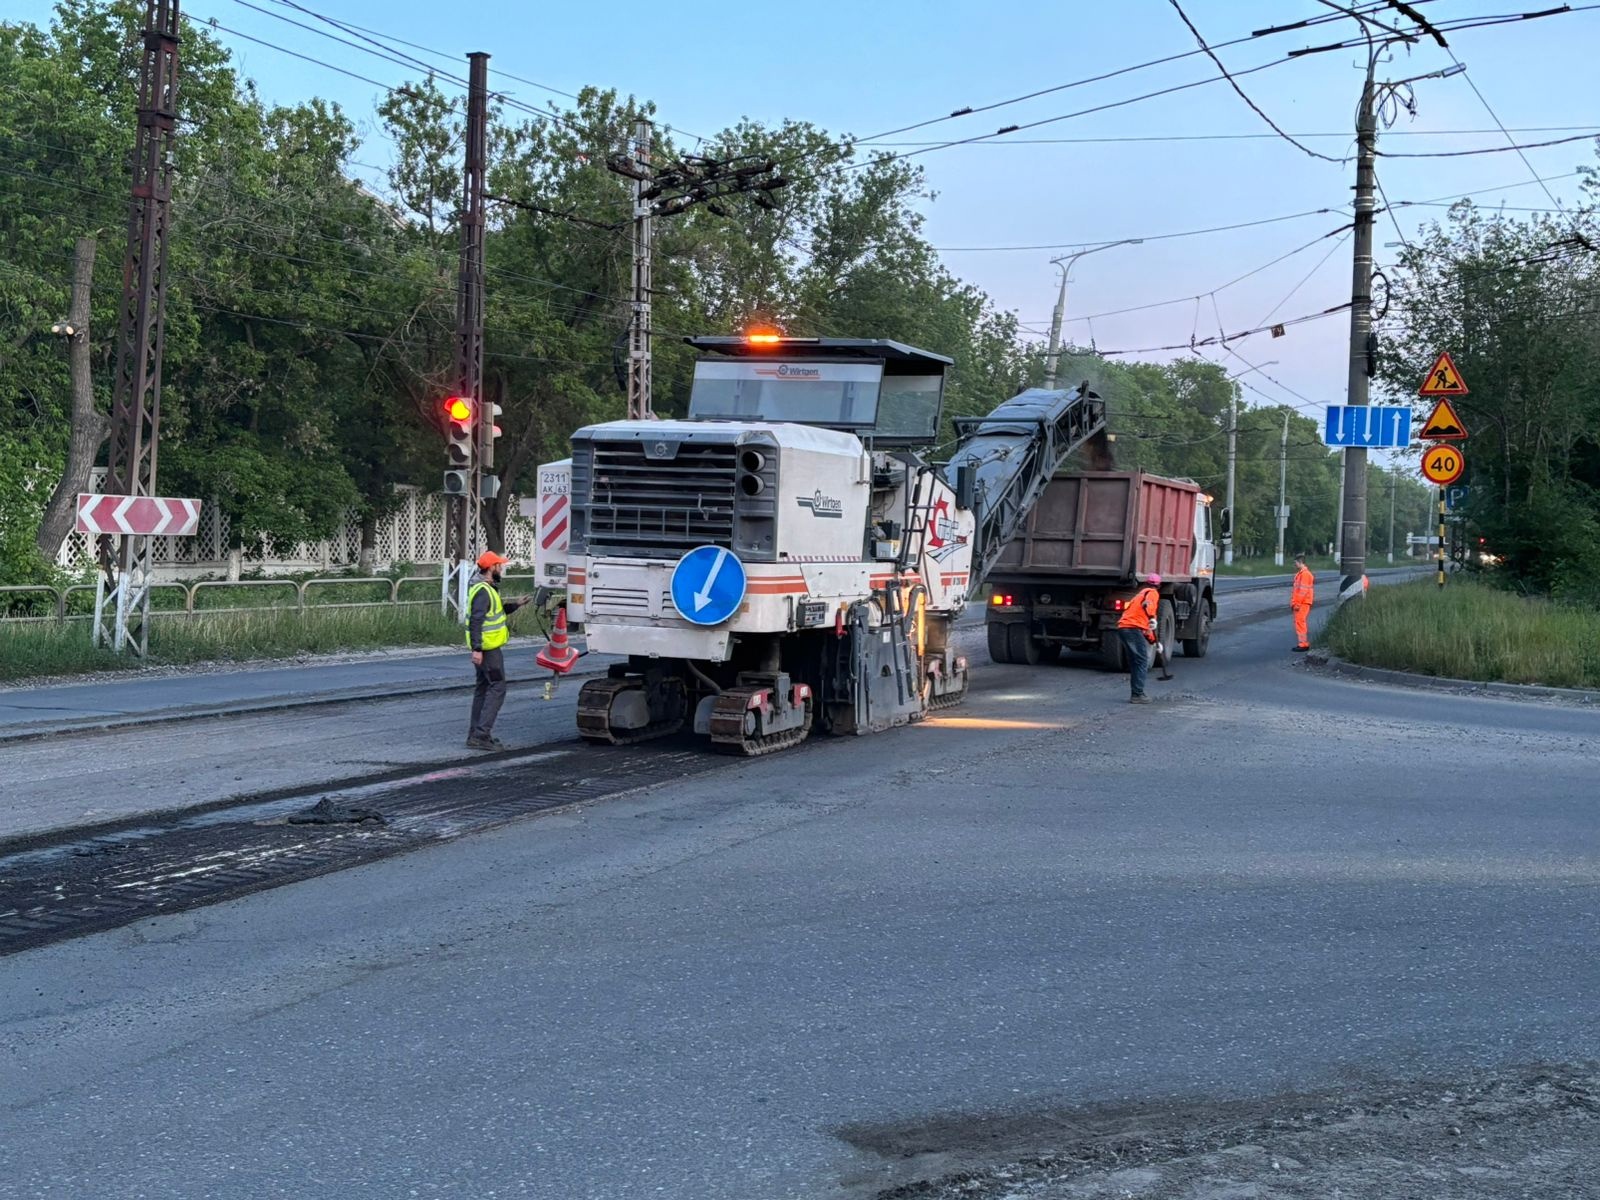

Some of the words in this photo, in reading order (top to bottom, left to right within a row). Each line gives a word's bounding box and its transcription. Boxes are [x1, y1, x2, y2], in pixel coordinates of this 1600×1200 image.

[790, 367, 819, 376] Wirtgen
[1431, 456, 1455, 472] 40
[544, 473, 566, 483] 2311
[1450, 488, 1464, 506] P
